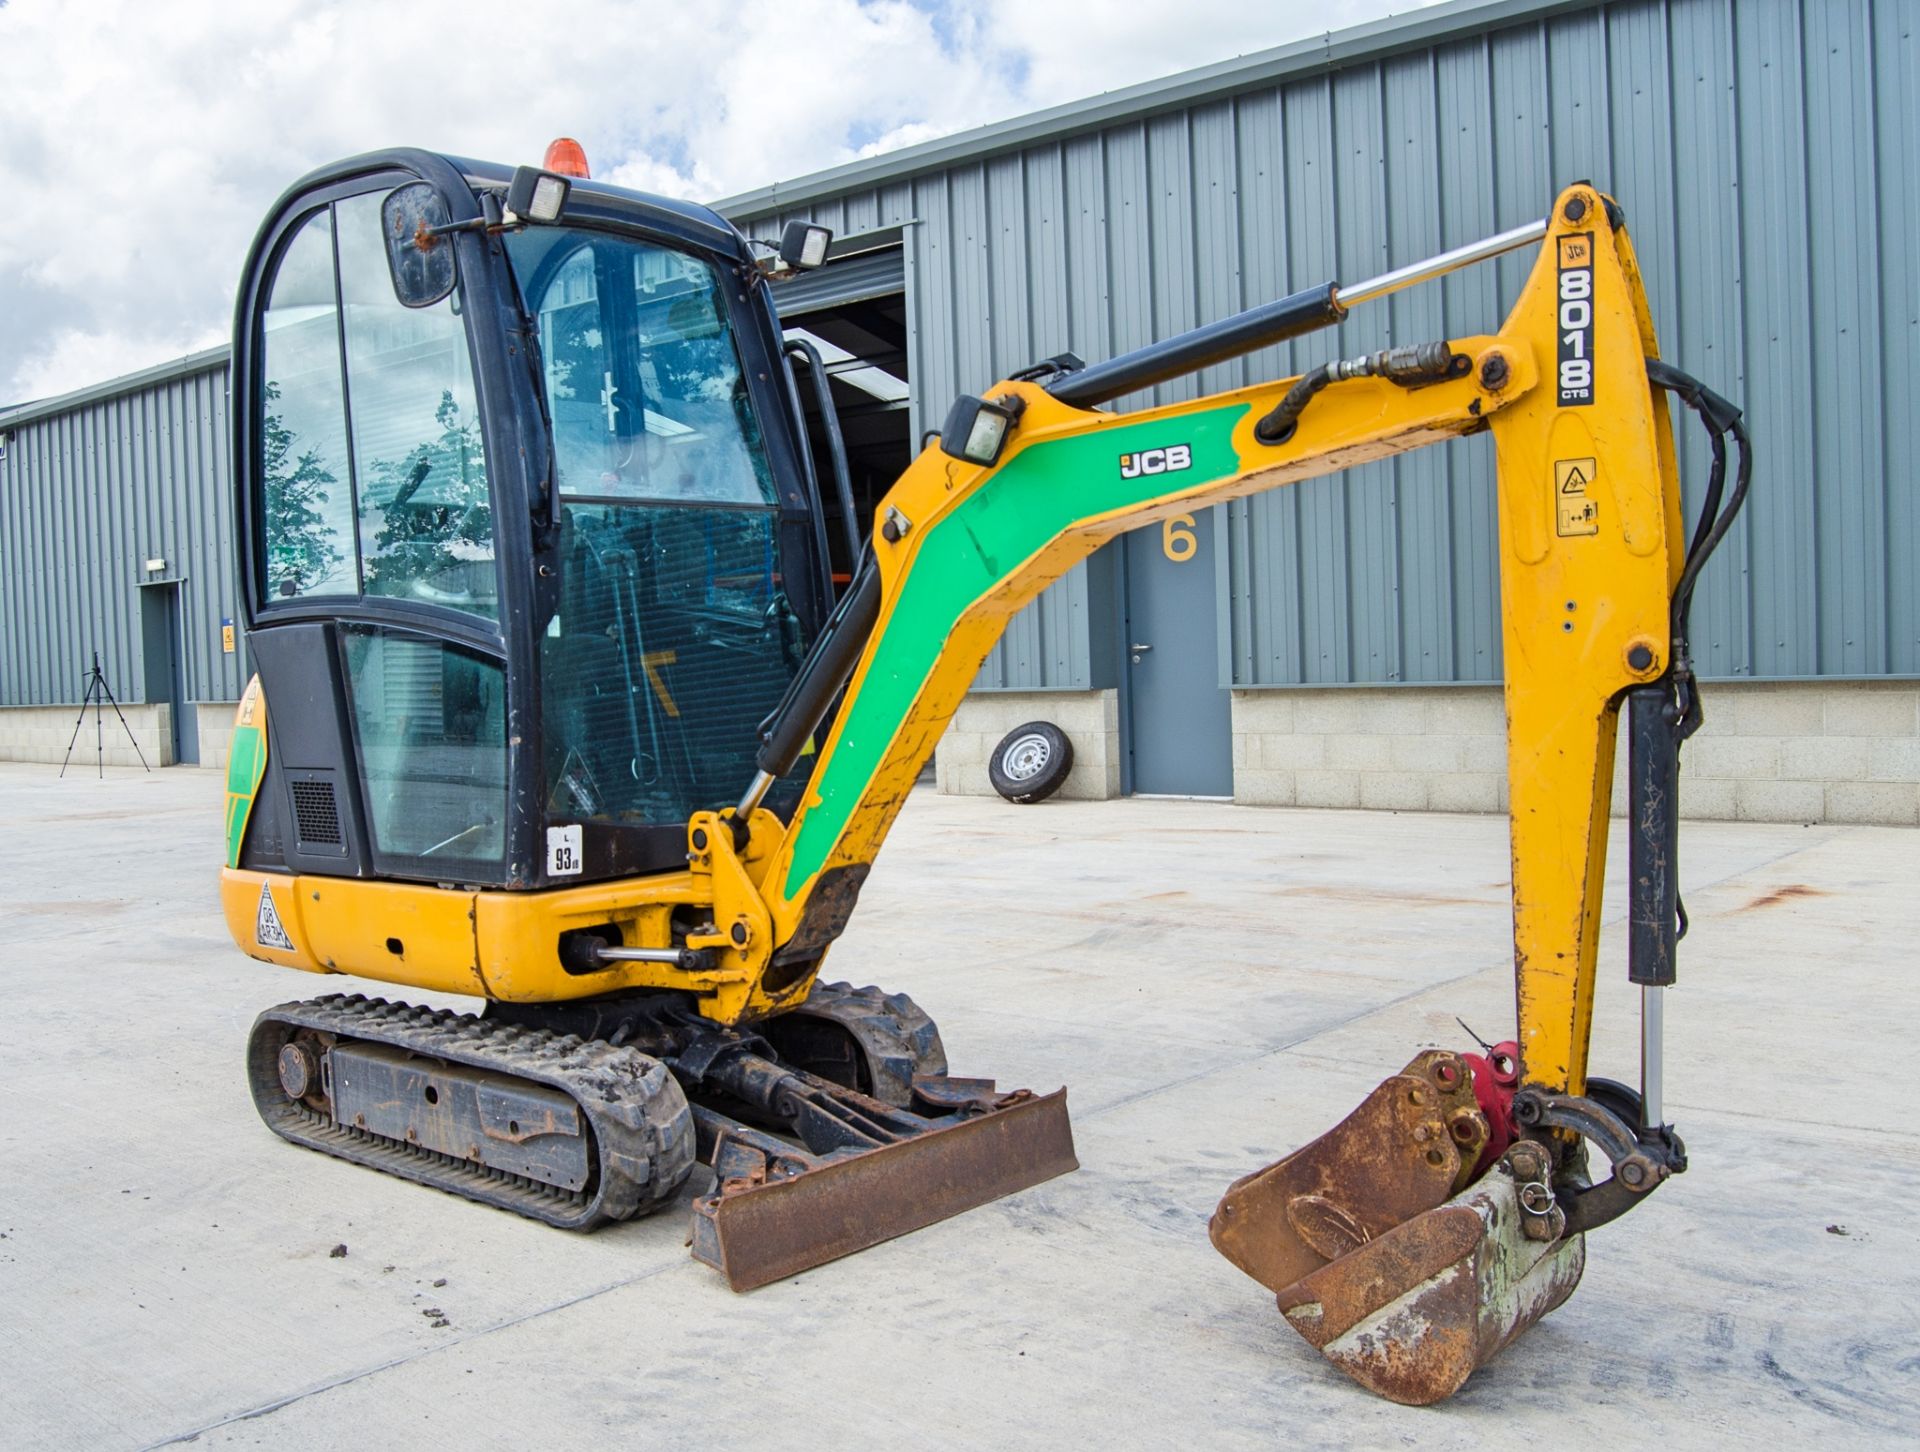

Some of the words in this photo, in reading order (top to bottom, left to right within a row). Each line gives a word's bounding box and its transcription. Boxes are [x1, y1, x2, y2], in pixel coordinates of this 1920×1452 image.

[1568, 244, 1585, 260] JCB
[1560, 270, 1591, 388] 8018
[1561, 388, 1589, 399] CTS
[1120, 444, 1192, 478] JCB
[1163, 513, 1198, 563] 6
[556, 847, 572, 870] 93
